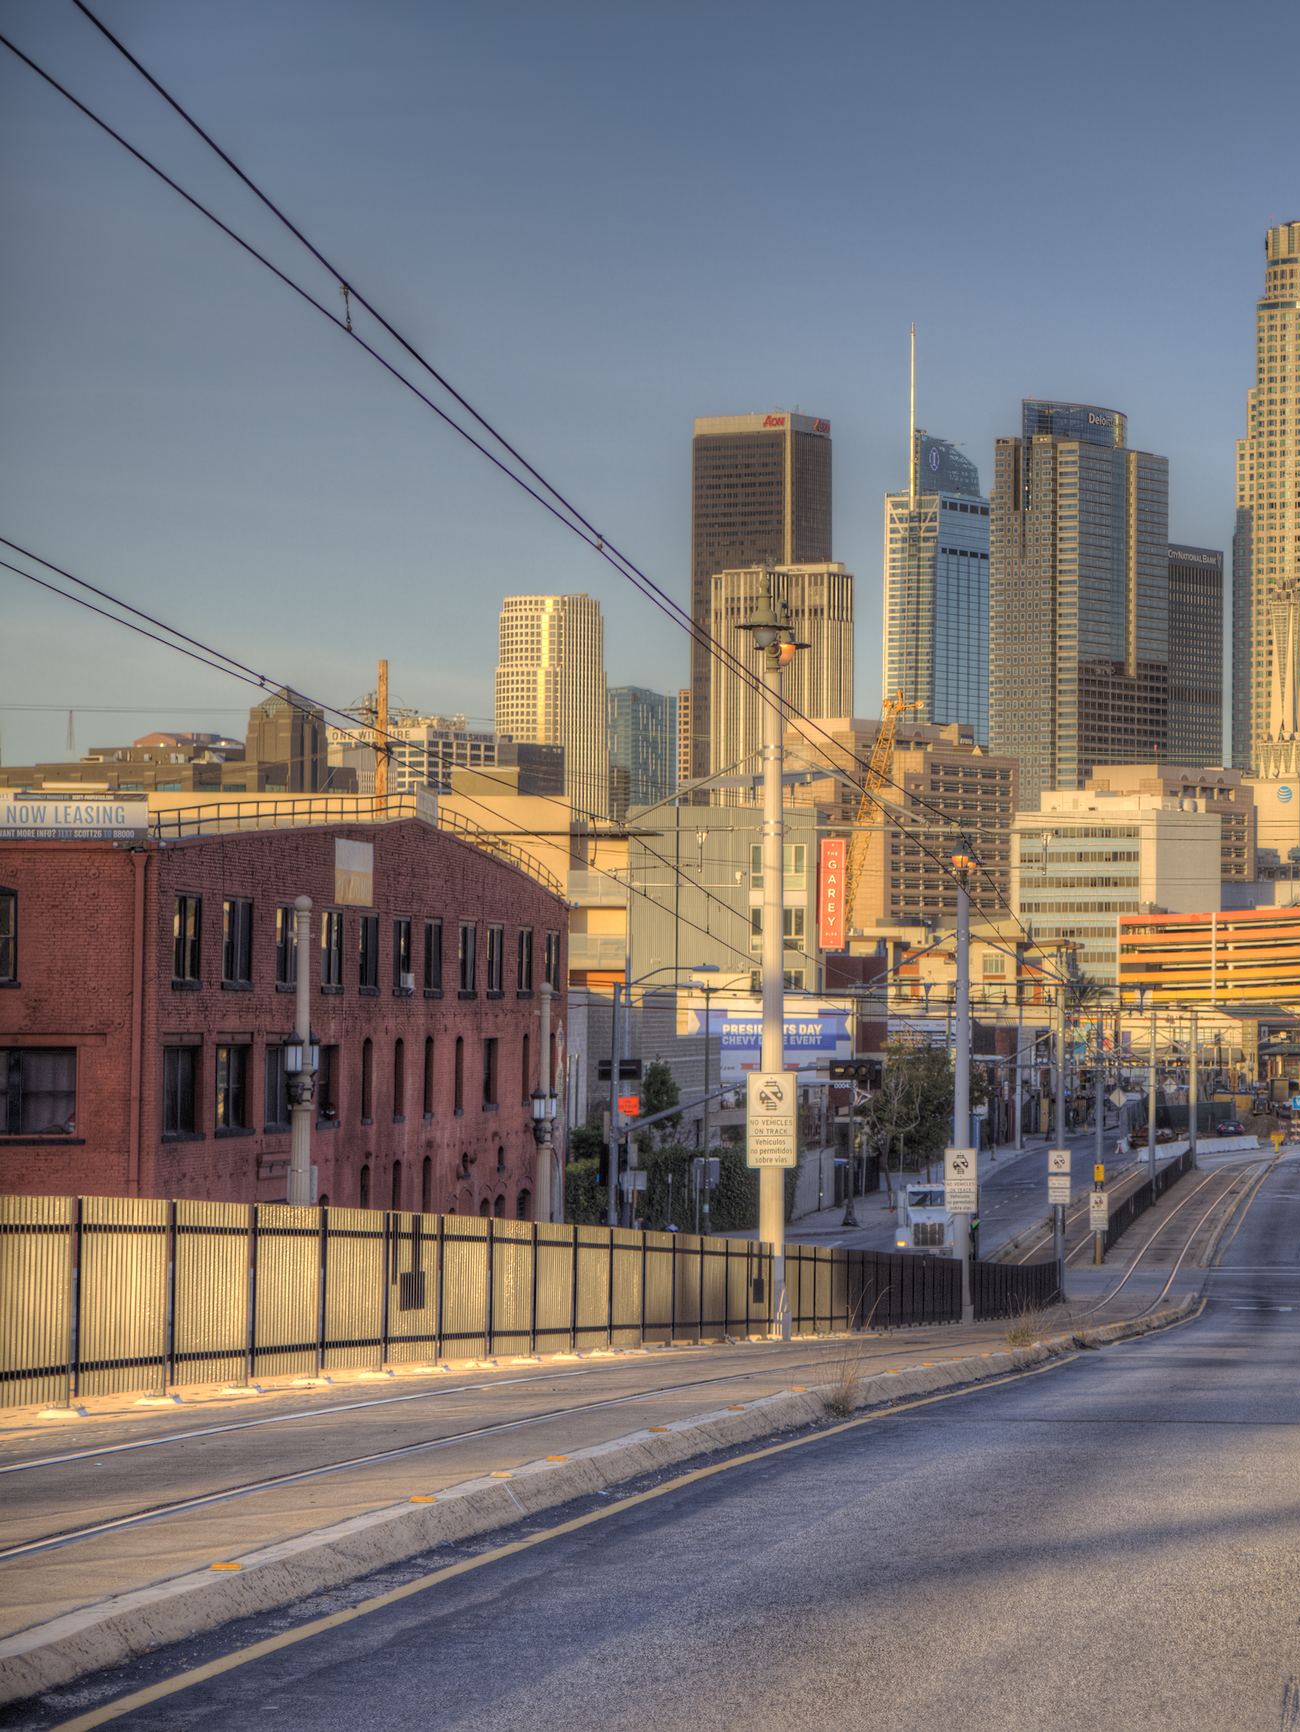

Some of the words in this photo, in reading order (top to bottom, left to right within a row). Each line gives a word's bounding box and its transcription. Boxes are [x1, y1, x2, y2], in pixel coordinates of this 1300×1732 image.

[332, 731, 353, 741] ONE
[6, 805, 47, 824] NOW
[54, 805, 126, 824] LEASING
[16, 829, 36, 838] MORE
[36, 829, 56, 838] INFO?
[57, 829, 73, 838] TEXT
[73, 829, 102, 838] SCOTT26
[103, 829, 112, 838] TO
[113, 829, 135, 838] 88000
[827, 860, 837, 926] GAREY
[799, 1024, 823, 1035] DAY
[722, 1036, 755, 1045] CHEVY
[790, 1036, 823, 1045] EVENT
[760, 1147, 793, 1155] permitidos
